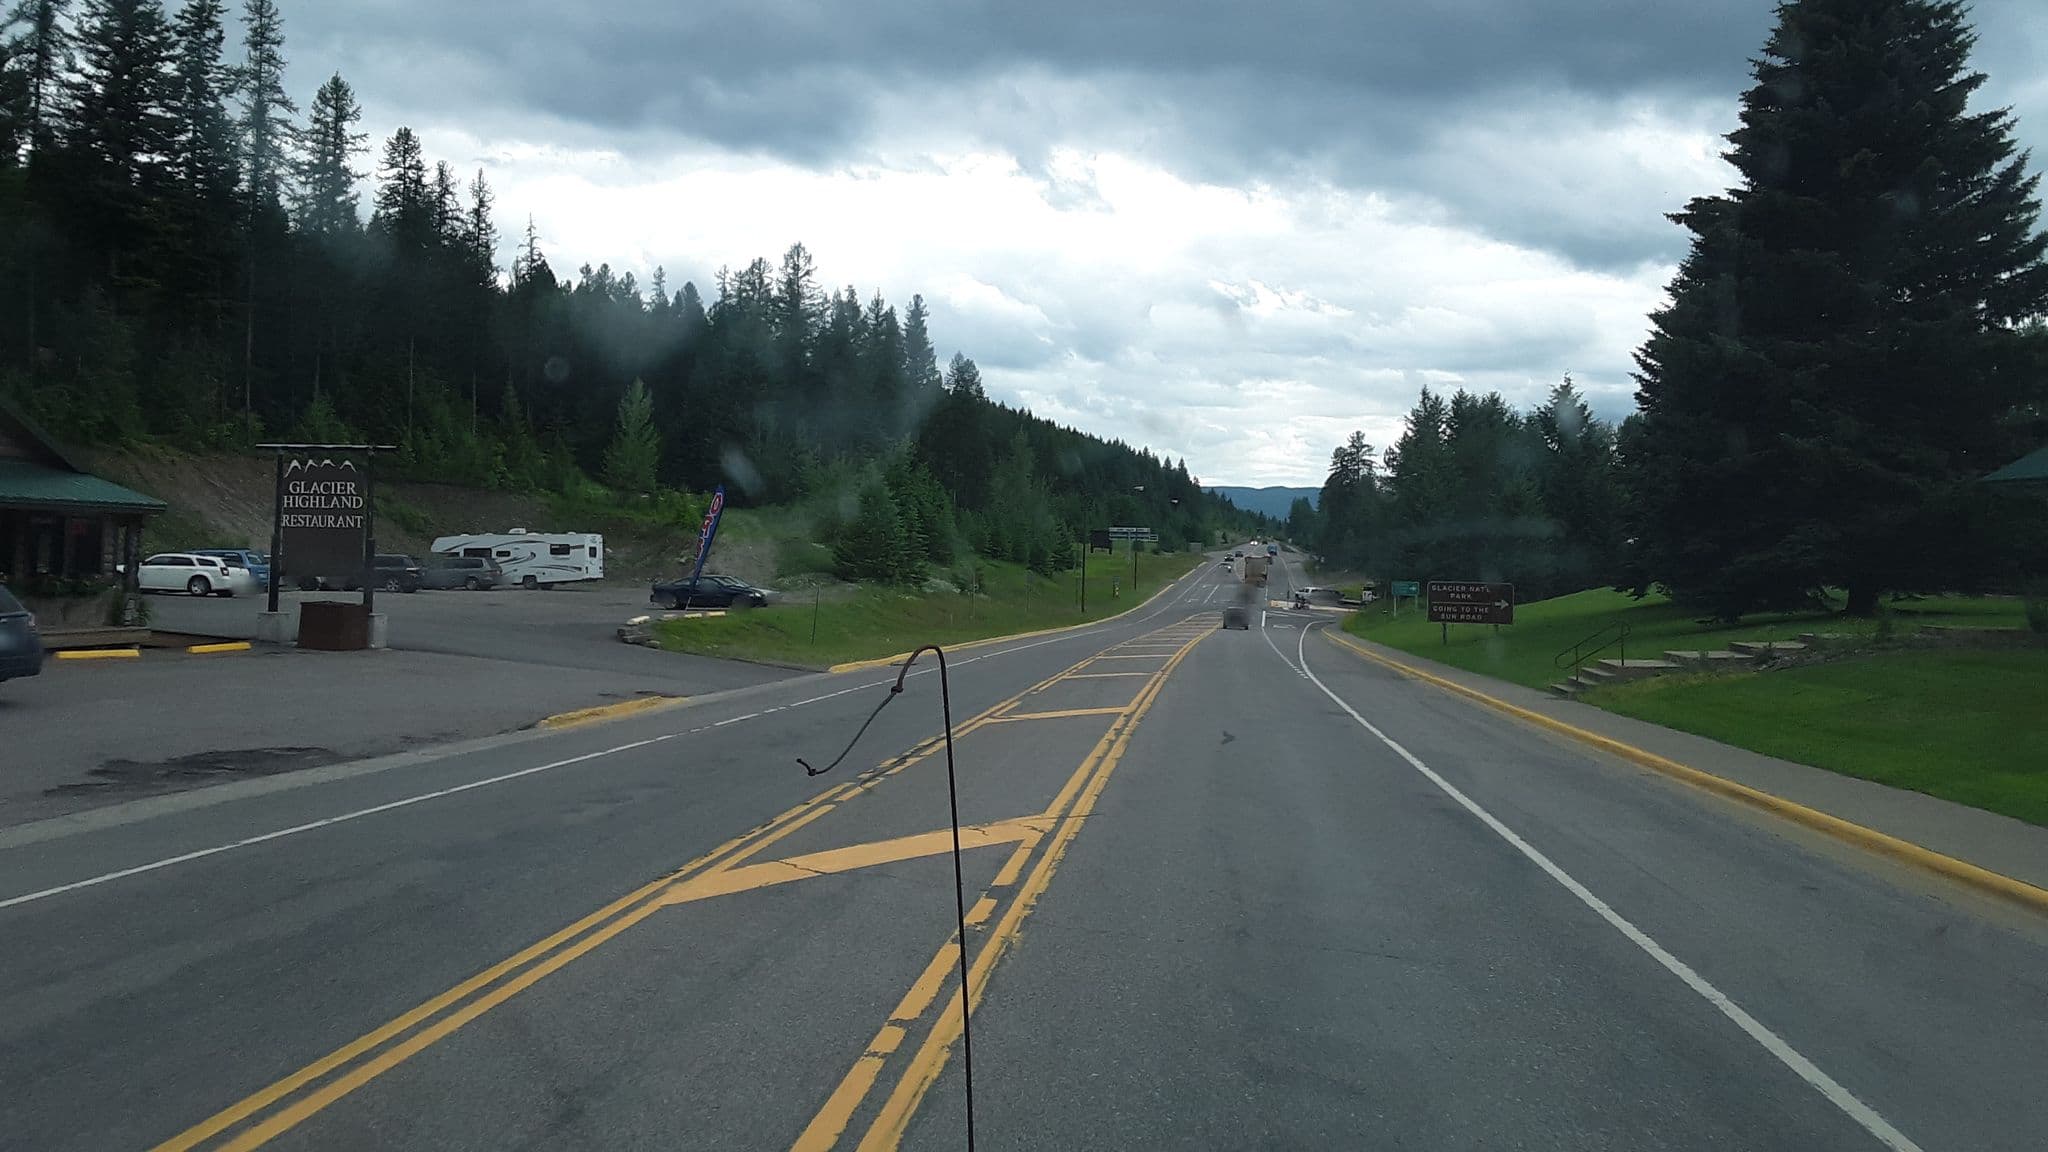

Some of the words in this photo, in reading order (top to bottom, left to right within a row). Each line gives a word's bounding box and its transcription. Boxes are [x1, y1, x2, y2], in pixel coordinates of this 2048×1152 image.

[289, 481, 357, 495] GLACIER
[283, 495, 364, 509] HIGHLAND
[282, 514, 364, 529] RESTAURANT
